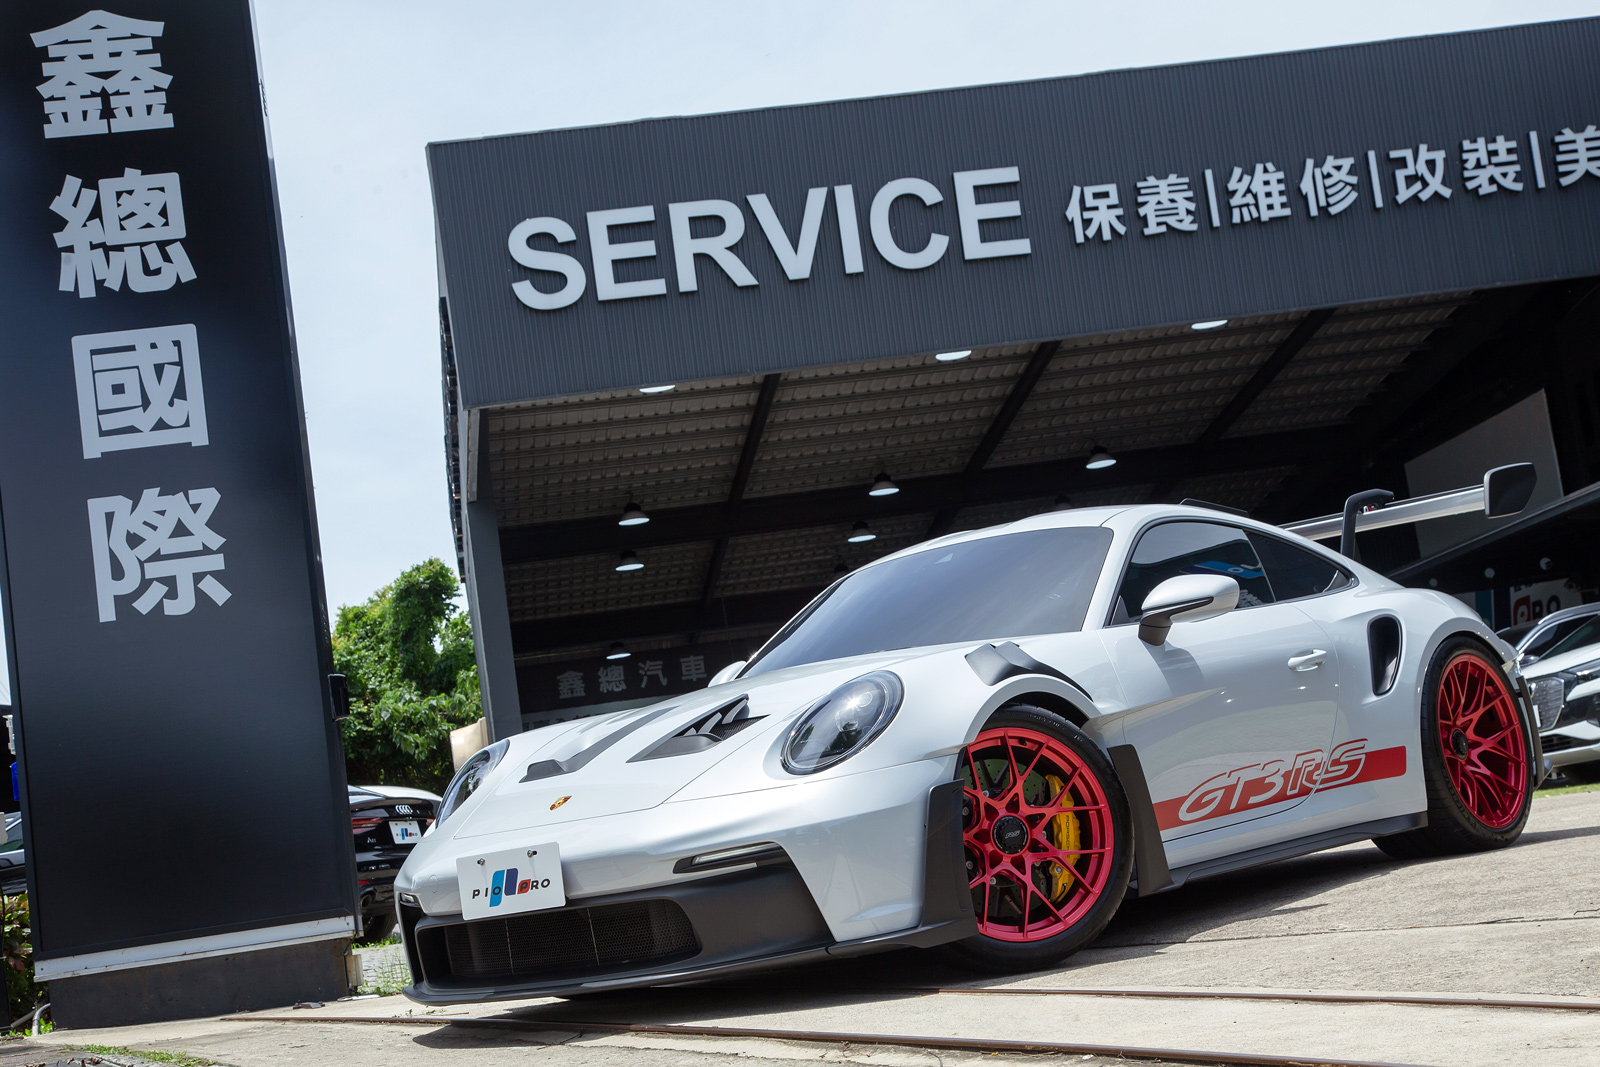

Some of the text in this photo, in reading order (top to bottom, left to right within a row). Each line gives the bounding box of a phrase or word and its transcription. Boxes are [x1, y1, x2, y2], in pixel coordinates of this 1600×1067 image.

[507, 166, 1032, 310] SERVICE
[29, 9, 233, 623] 鑫總國際
[556, 655, 708, 699] 鑫總汽車
